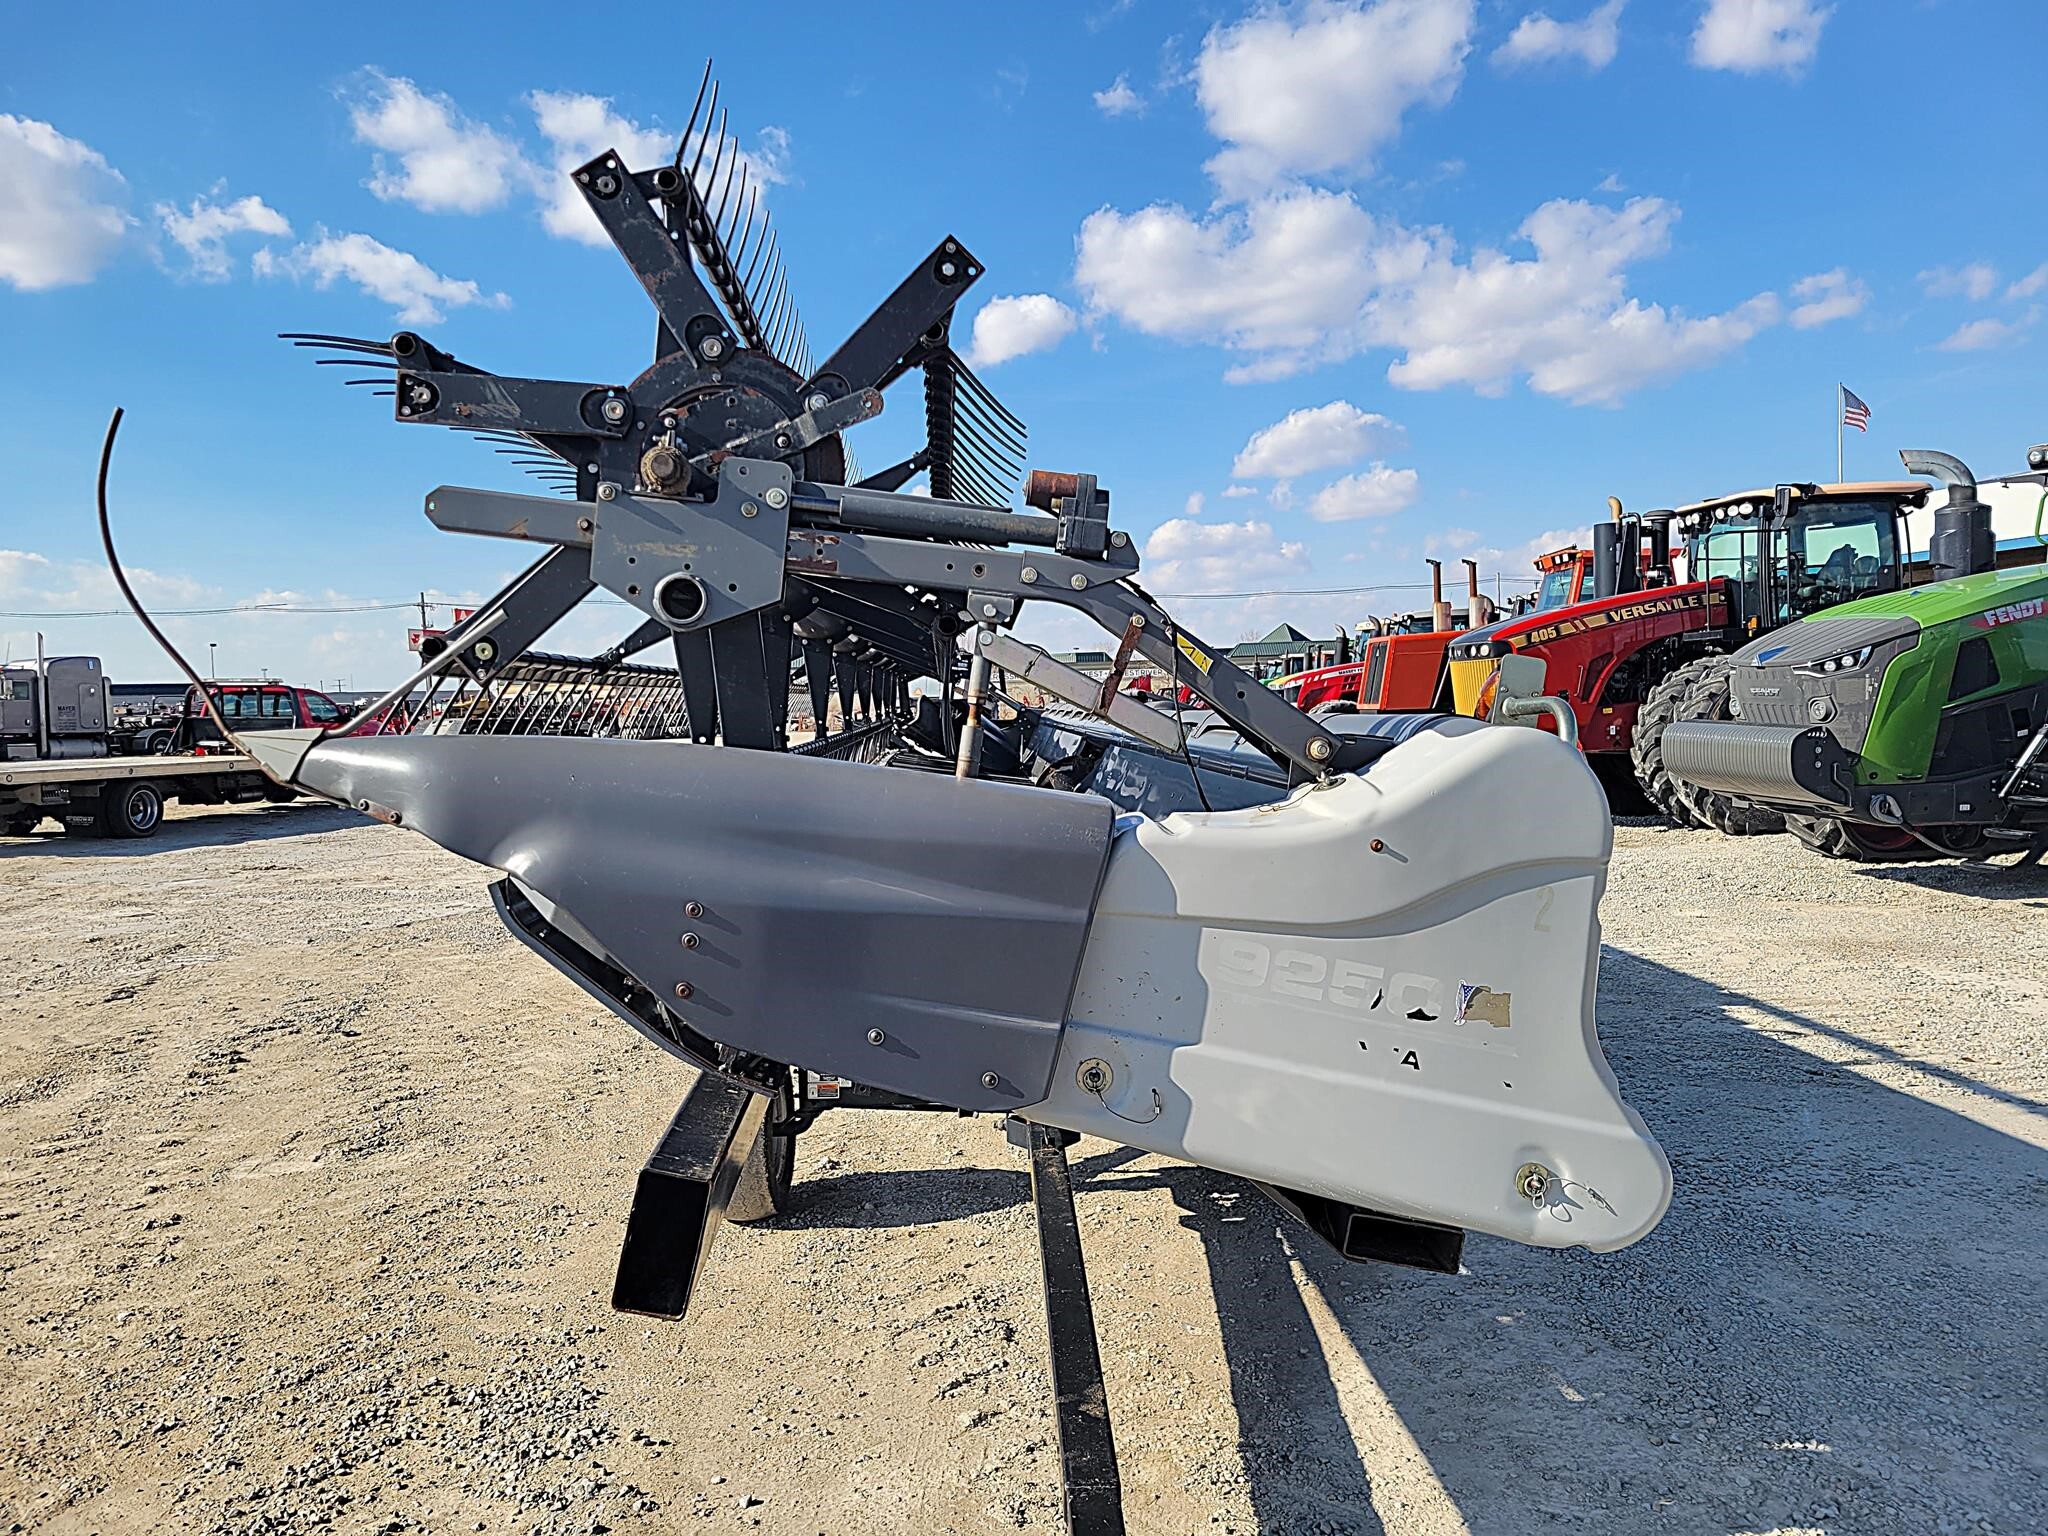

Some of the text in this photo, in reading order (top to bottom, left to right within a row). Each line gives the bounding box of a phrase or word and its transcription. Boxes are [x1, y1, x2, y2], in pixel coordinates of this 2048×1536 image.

[1983, 597, 2044, 627] FENDT
[1530, 626, 1557, 643] 405
[1533, 885, 1555, 933] 2
